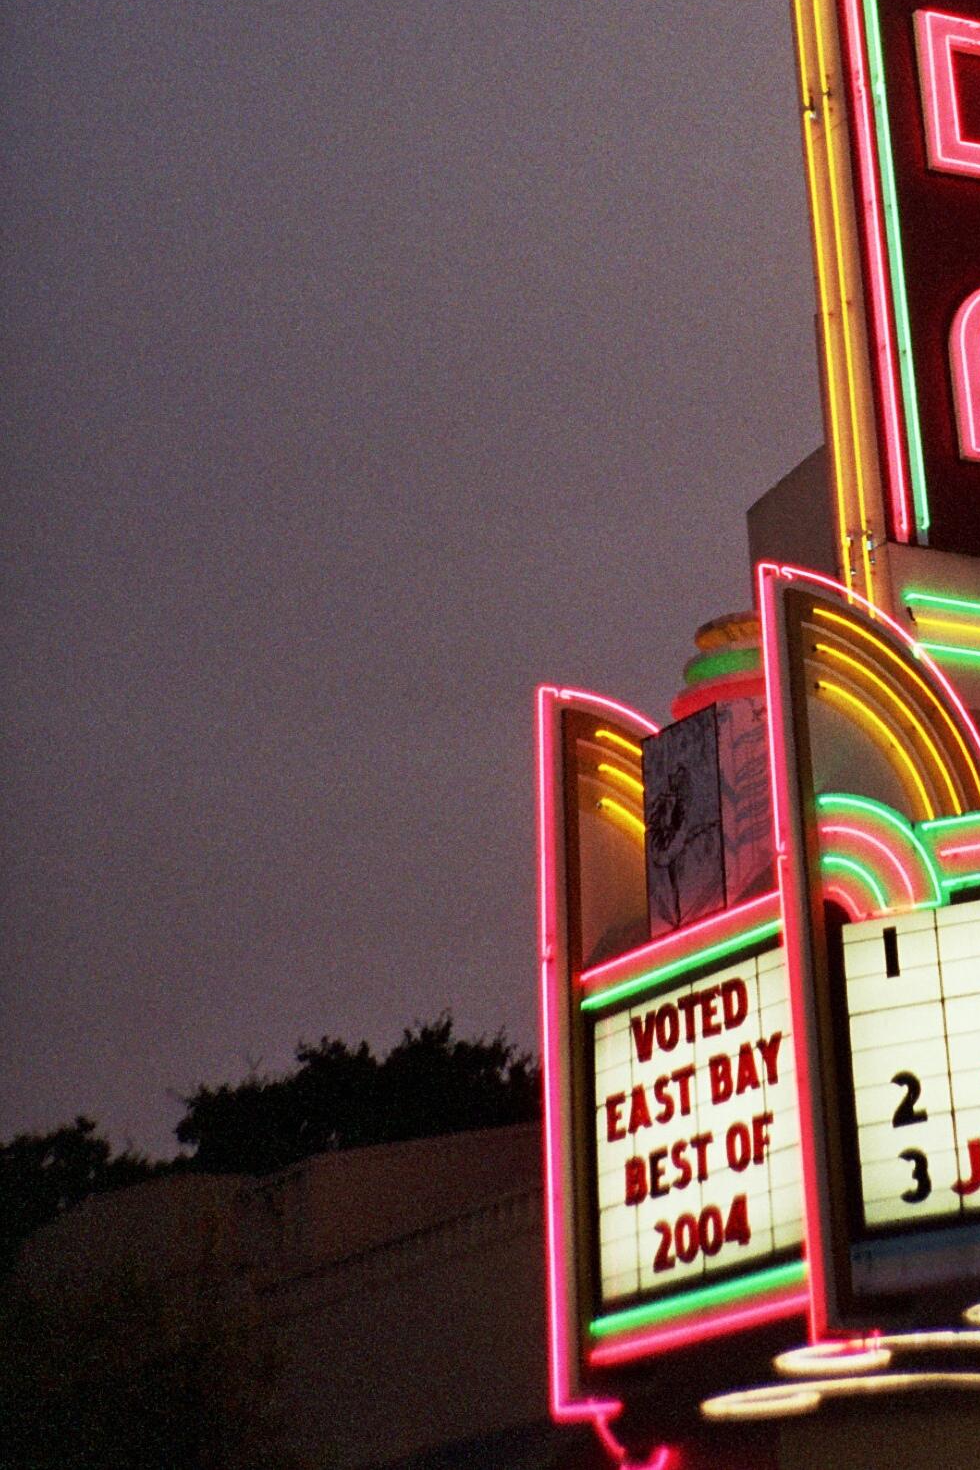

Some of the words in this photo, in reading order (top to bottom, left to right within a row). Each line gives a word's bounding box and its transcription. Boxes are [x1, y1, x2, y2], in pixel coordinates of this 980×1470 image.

[631, 977, 749, 1063] VOTED
[605, 1063, 695, 1143] EAST
[709, 1031, 782, 1106] BAY
[890, 1071, 928, 1128] 2
[624, 1132, 713, 1207] BEST
[726, 1111, 774, 1173] OF
[897, 1148, 933, 1205] 3
[653, 1192, 751, 1274] 2004
